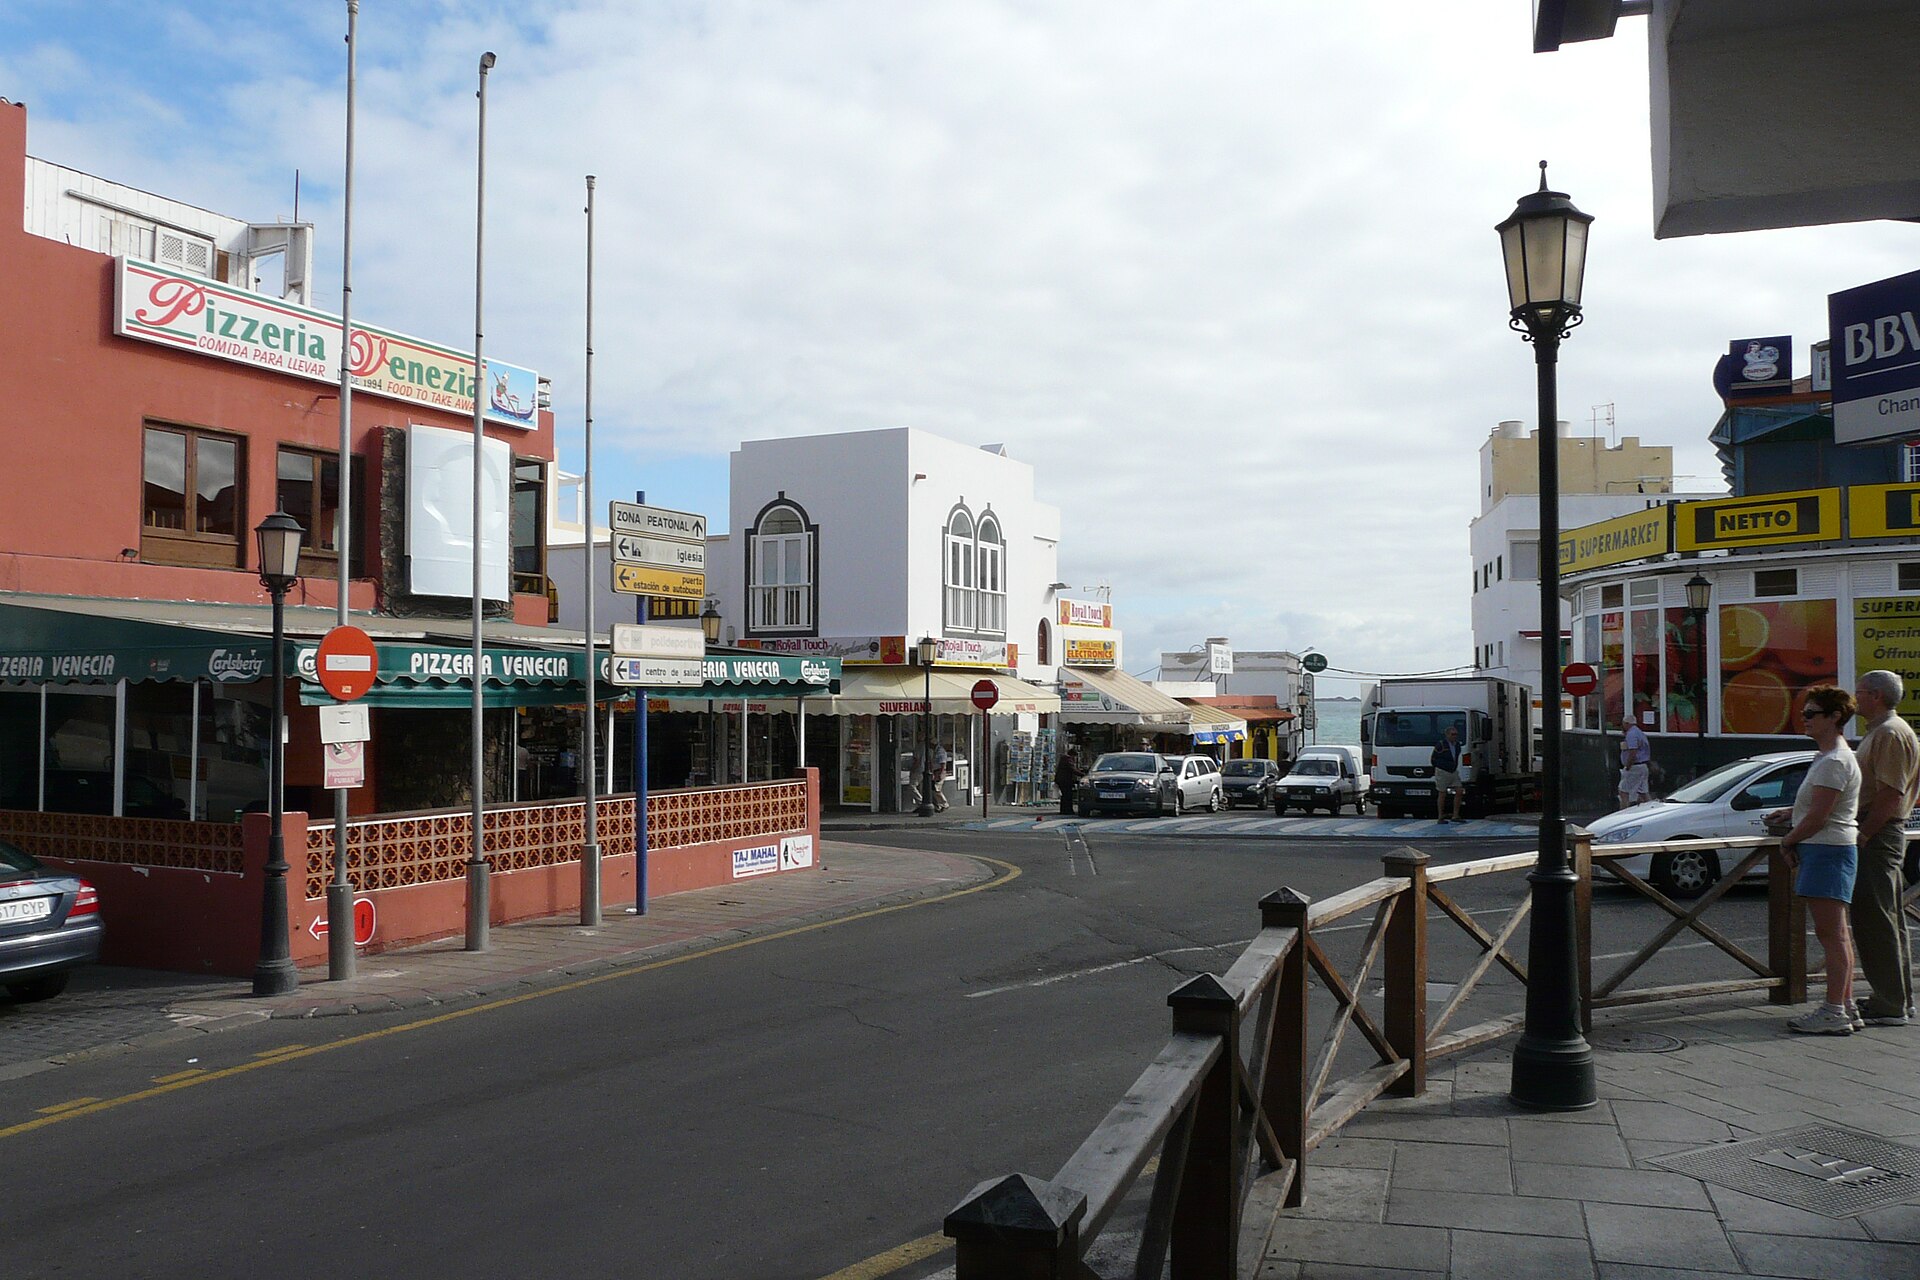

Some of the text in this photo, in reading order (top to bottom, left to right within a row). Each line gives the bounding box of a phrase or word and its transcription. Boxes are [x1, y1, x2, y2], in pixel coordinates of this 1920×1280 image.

[135, 278, 326, 360] Pizzeria
[198, 335, 326, 377] COMIDA PARA LLEVAR
[363, 378, 382, 391] 1994
[387, 381, 475, 412] FOOD TO TAKE AWA
[1878, 397, 1920, 415] Chan
[617, 510, 689, 532] ZONA PEATONAL
[1720, 509, 1792, 532] NETTO
[1580, 521, 1659, 558] SUPERMARKET
[677, 548, 702, 563] iglesia
[633, 580, 702, 596] estación de autobuses
[682, 576, 702, 586] puerto
[776, 638, 828, 651] Royall Touch
[964, 640, 982, 653] Touch
[208, 649, 264, 676] Carlsberg
[1067, 650, 1113, 658] ELECTRONICS
[52, 654, 115, 676] VENECIA
[411, 652, 569, 677] PIZZERA VENECIA
[645, 667, 700, 677] centro de salud
[733, 660, 780, 678] VENECIA
[801, 660, 830, 679] Carlsberg
[734, 847, 776, 863] TAJ MAHAL
[22, 902, 45, 915] CYP
